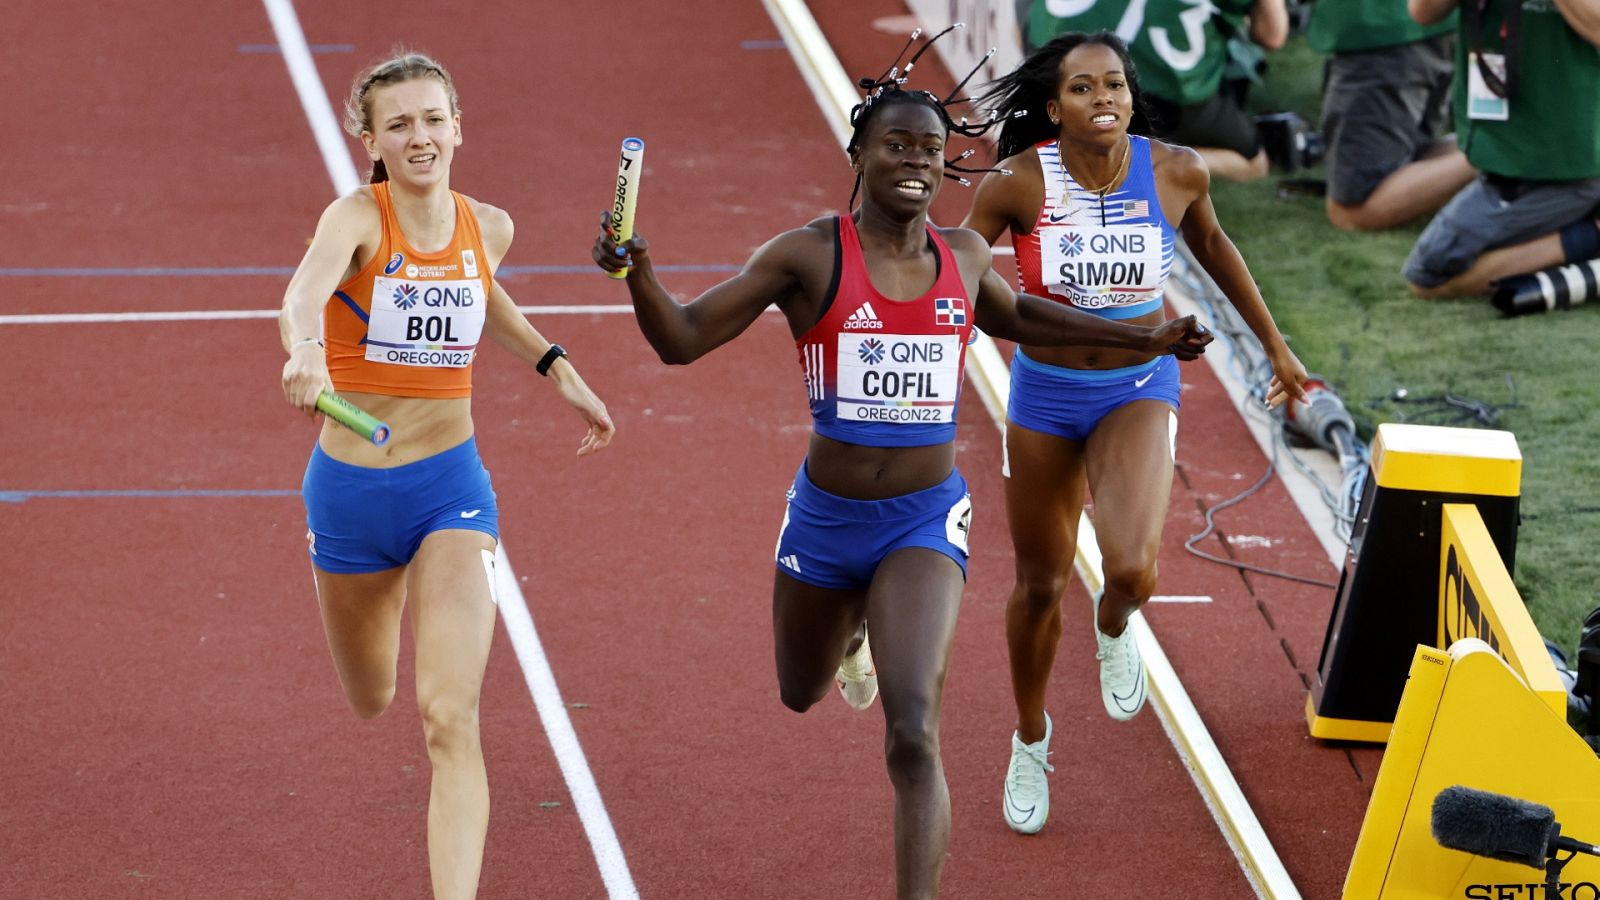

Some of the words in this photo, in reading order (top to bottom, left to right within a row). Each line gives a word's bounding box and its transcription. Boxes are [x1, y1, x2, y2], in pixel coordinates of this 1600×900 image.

[611, 175, 628, 246] OREGON2
[1090, 234, 1146, 254] QNB
[1059, 262, 1145, 286] SIMON
[424, 287, 474, 307] QNB
[1065, 288, 1135, 307] OREGON22
[406, 316, 459, 342] BOL
[843, 318, 883, 329] adidas
[386, 350, 470, 365] OREGON22
[891, 342, 944, 363] QNB
[862, 370, 939, 398] COFIL
[856, 406, 942, 421] OREGON22
